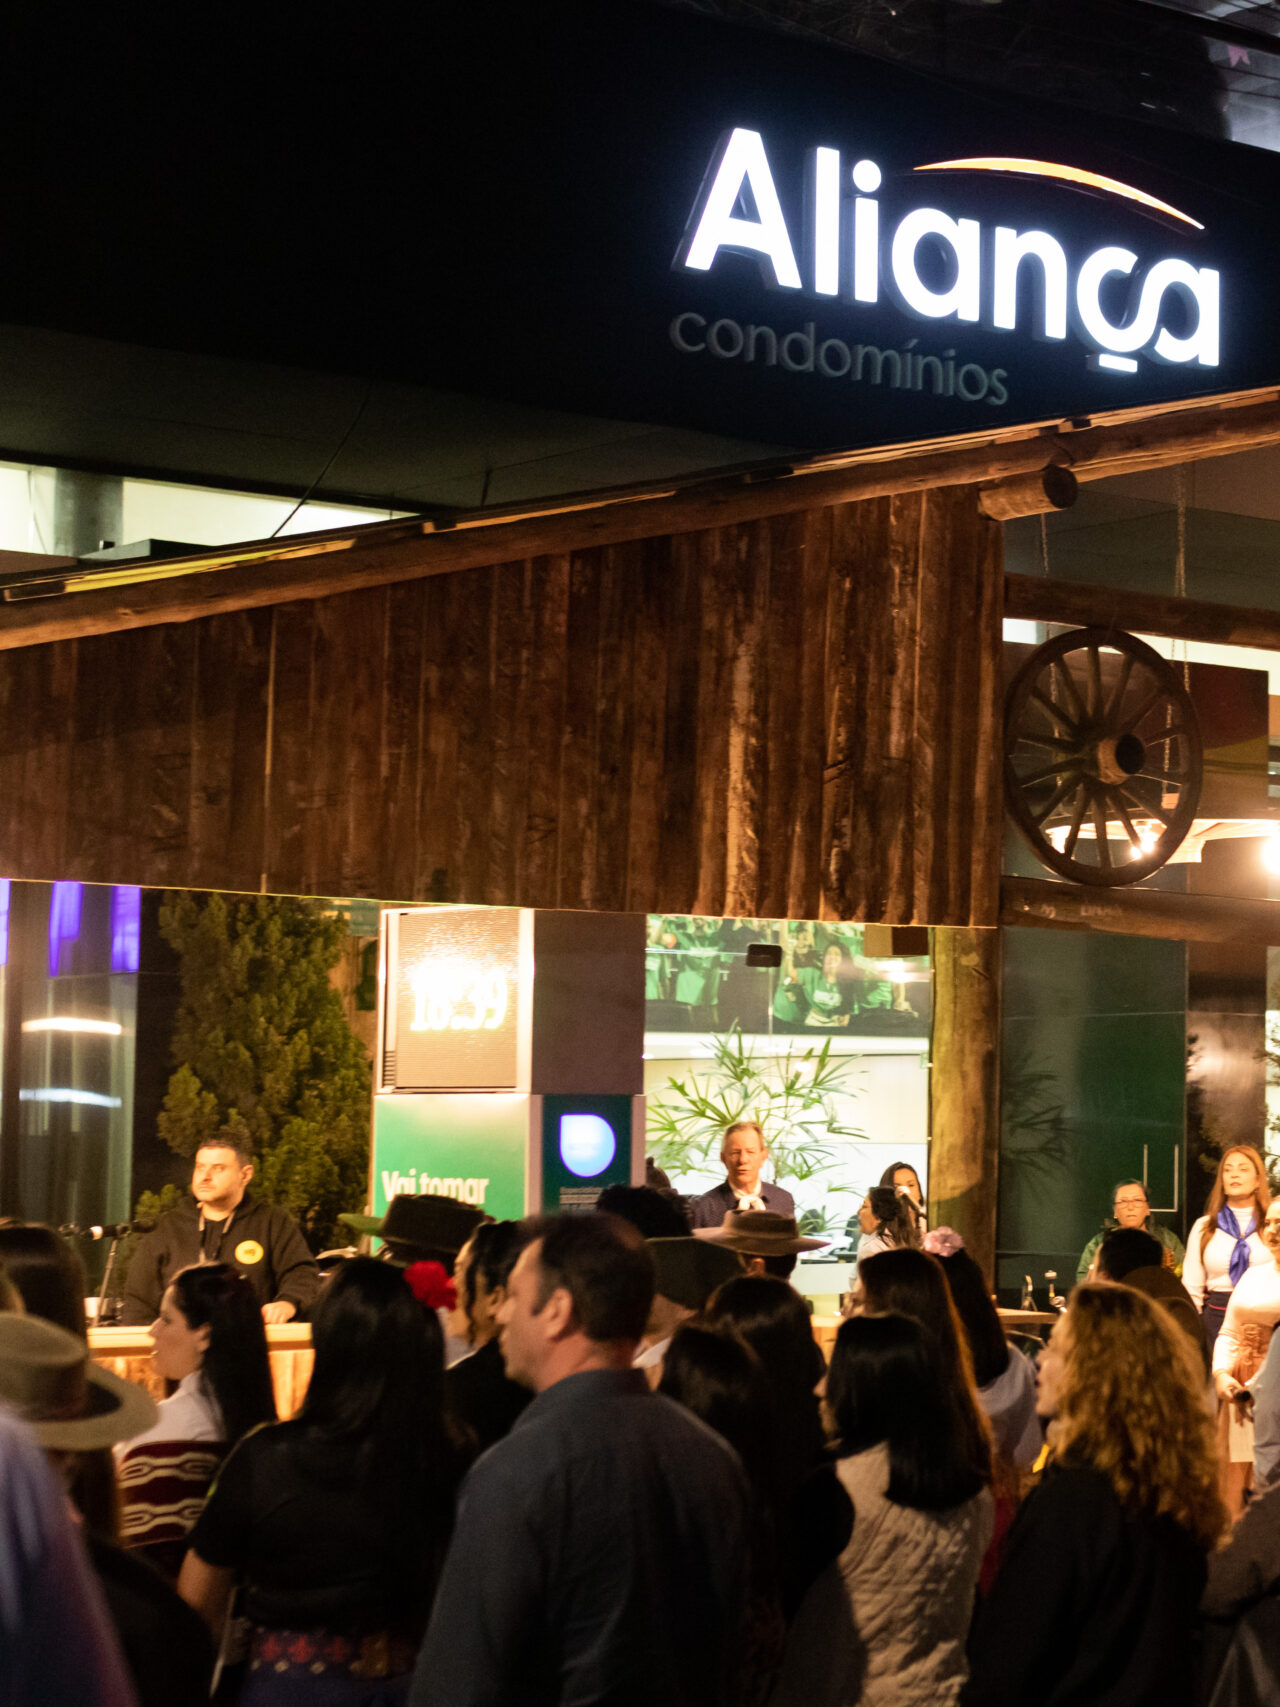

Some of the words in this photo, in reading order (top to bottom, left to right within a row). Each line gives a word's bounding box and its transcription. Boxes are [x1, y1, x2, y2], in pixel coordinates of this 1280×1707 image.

[680, 127, 1221, 373] Aliança
[669, 311, 1010, 406] condomínios
[381, 1168, 417, 1202] Vai
[419, 1172, 490, 1204] tomar
